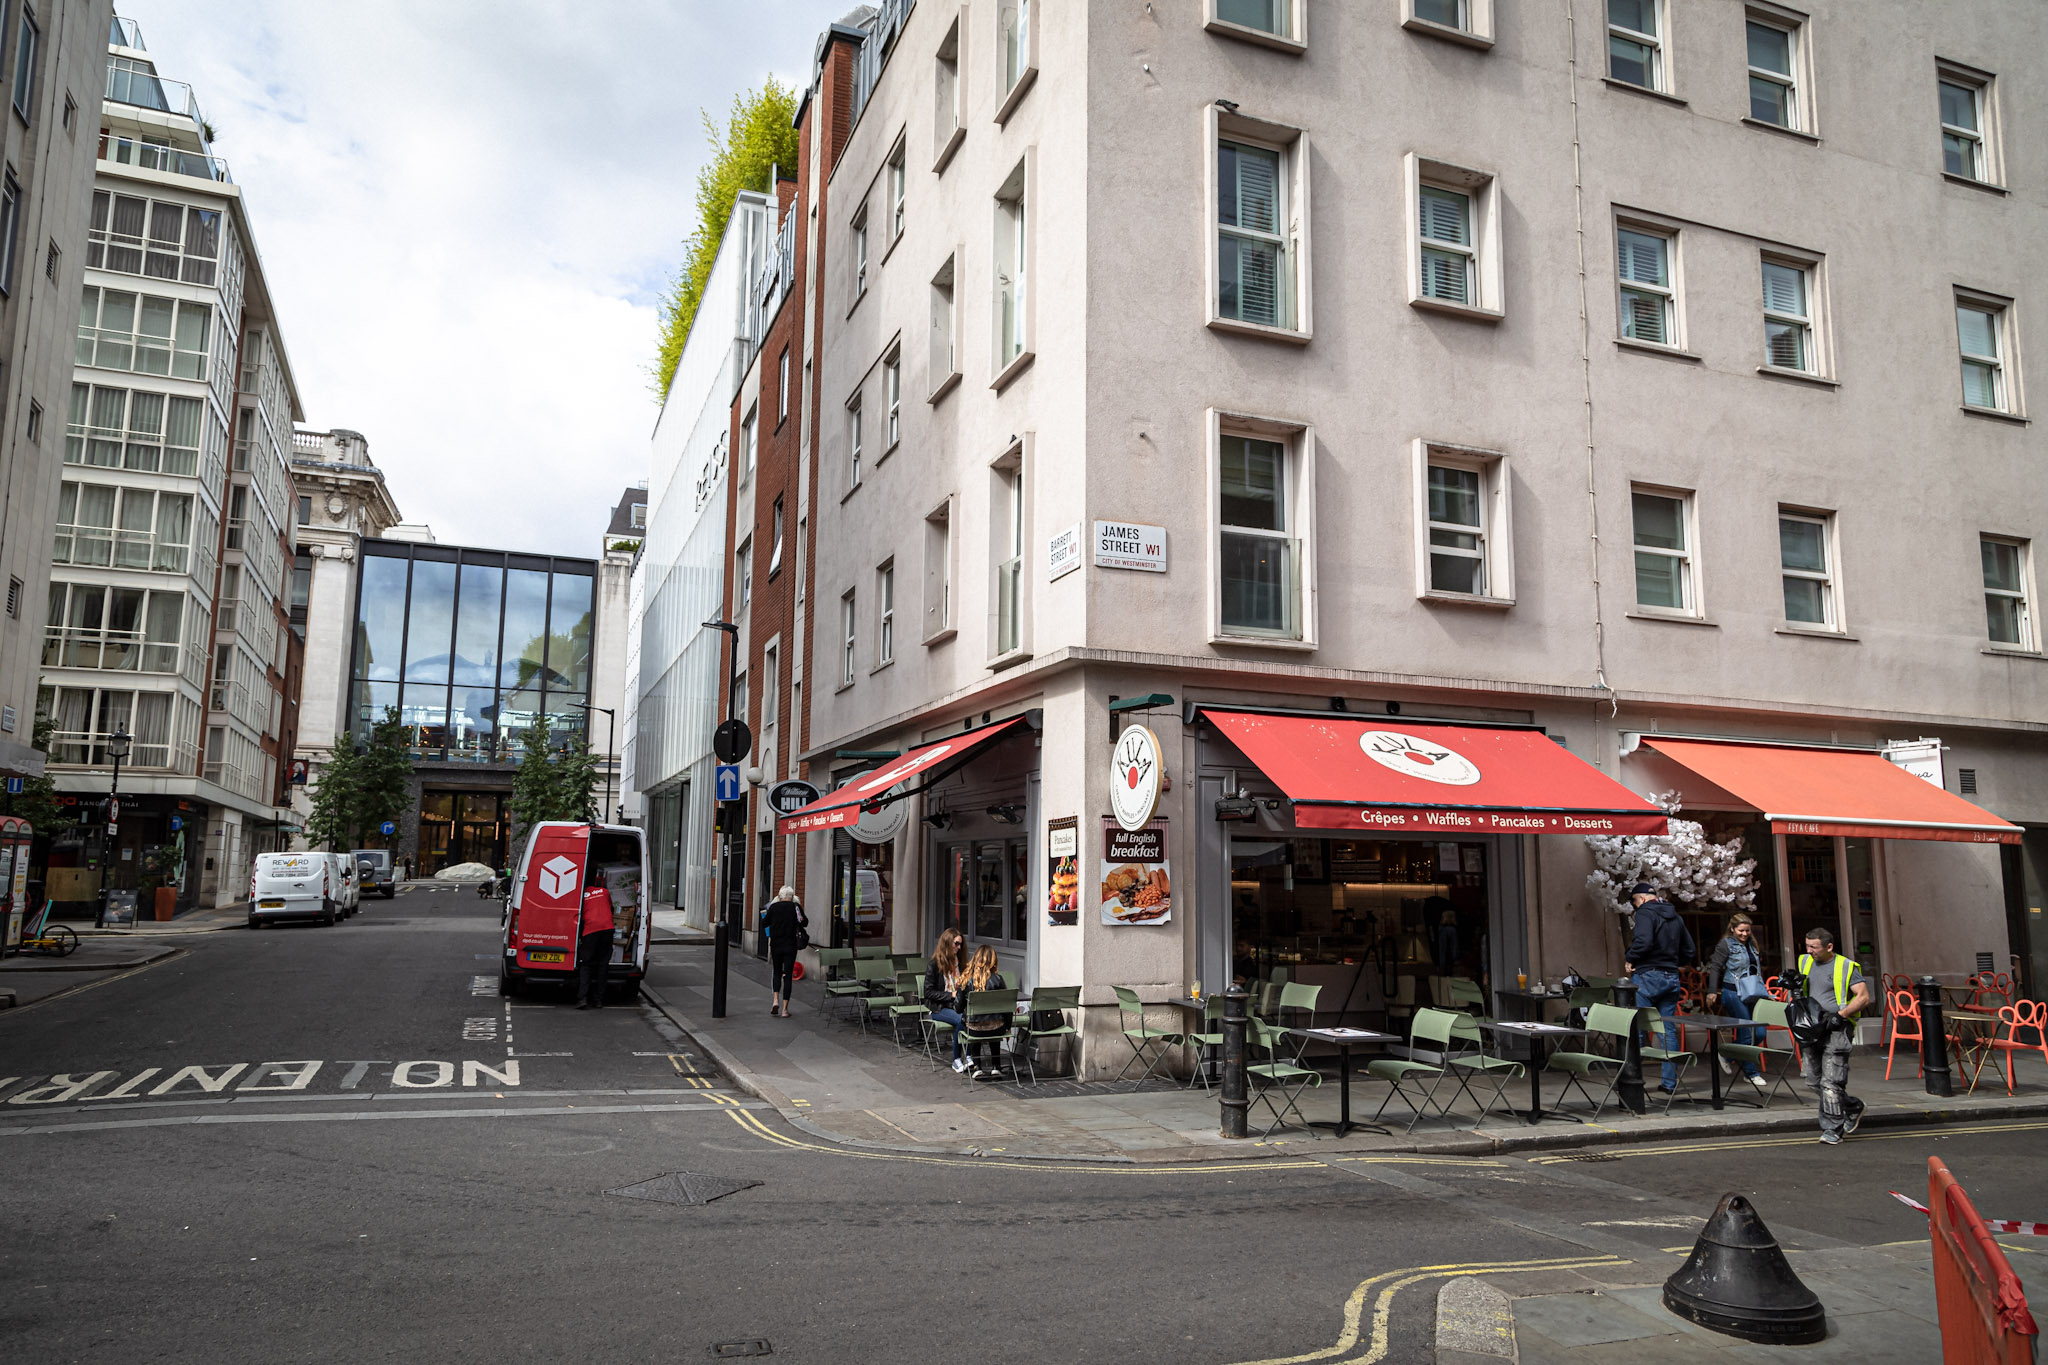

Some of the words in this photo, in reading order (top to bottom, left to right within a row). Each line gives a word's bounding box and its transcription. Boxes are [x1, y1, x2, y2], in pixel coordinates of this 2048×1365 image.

[694, 429, 728, 513] REISS
[1050, 530, 1072, 552] BARRETT
[1102, 525, 1139, 540] JAMES
[1050, 546, 1068, 566] STREET
[1069, 542, 1077, 556] W1
[1102, 539, 1141, 554] STREET
[1145, 543, 1160, 556] W1
[1122, 559, 1156, 569] WESTMINSTER
[1371, 735, 1450, 761] KULA
[813, 814, 826, 826] Pancakes
[830, 812, 844, 823] Desserts
[883, 813, 900, 832] PANCAKES
[1361, 810, 1405, 826] Crêpes
[1426, 812, 1471, 826] Waffles
[1491, 814, 1545, 828] Pancakes
[1565, 816, 1613, 829] Desserts
[1804, 823, 1819, 834] CAFE
[1115, 832, 1128, 843] full
[1129, 833, 1156, 845] English
[1110, 844, 1159, 858] breakfast
[272, 858, 309, 867] REWARD
[0, 1060, 325, 1104] ENTR
[391, 1060, 520, 1088] NO
